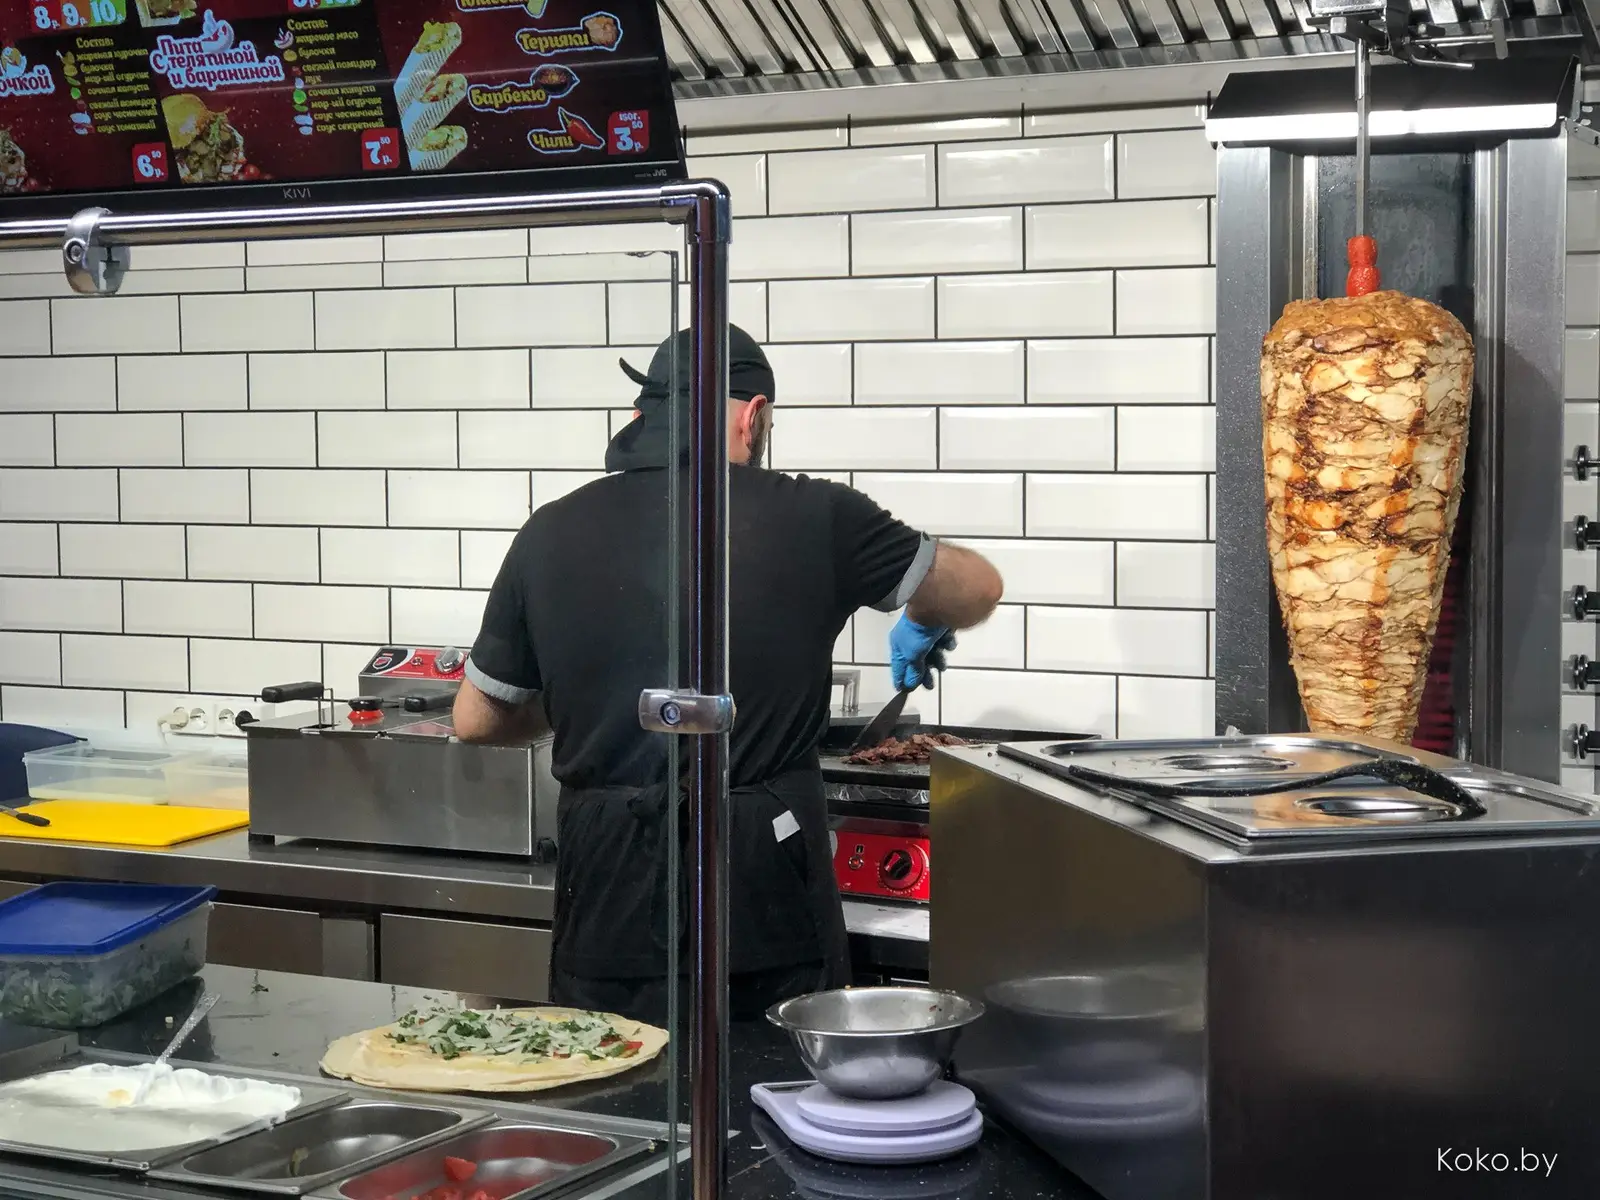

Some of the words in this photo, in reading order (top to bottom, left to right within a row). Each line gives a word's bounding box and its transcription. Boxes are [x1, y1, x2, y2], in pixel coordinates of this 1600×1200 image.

[287, 19, 328, 31] Состав:
[76, 38, 114, 49] Состав:
[161, 39, 204, 55] Пита
[295, 33, 335, 44] жареное
[336, 31, 359, 40] мясо
[519, 33, 590, 52] Терияки
[167, 45, 256, 68] телятиной
[170, 73, 183, 85] и
[185, 59, 281, 87] бараниной
[471, 87, 546, 107] Барбекю
[532, 133, 574, 149] Чили
[613, 127, 633, 151] 3
[365, 141, 381, 164] 7
[137, 154, 154, 178] 6
[283, 187, 312, 199] KIVI
